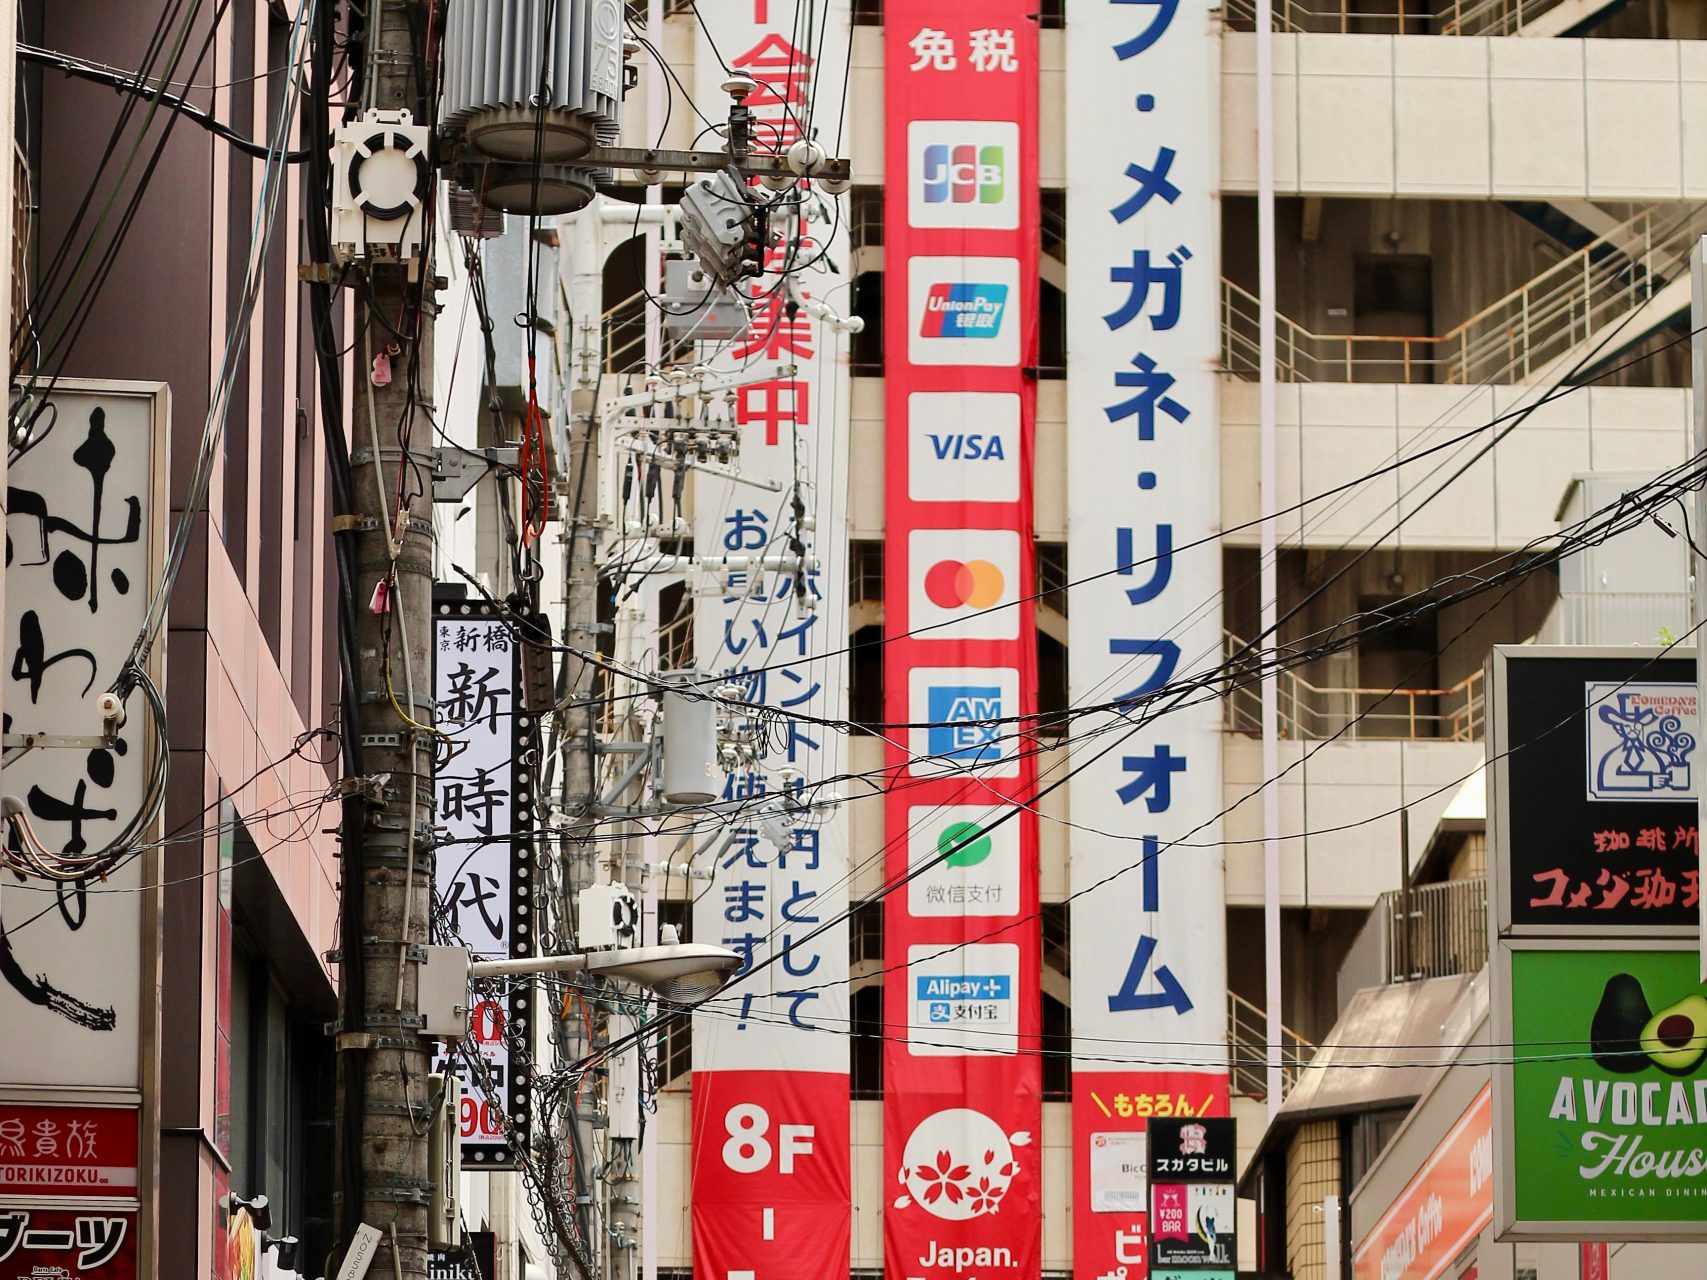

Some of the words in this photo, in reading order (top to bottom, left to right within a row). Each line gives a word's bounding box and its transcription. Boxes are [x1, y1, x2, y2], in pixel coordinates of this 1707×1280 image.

[908, 27, 1019, 73] 免税
[928, 296, 1003, 317] UnionPay
[925, 434, 1006, 461] VISA
[440, 625, 450, 652] 東京
[453, 625, 509, 653] 新橋
[1653, 705, 1698, 717] Coffee
[952, 726, 1001, 749] EX
[440, 661, 511, 941] 新時代
[926, 884, 1004, 905] 微信支付
[953, 1004, 999, 1021] 支付宝
[1113, 1093, 1196, 1119] もちろん
[722, 1102, 816, 1175] 8F
[1578, 1130, 1707, 1181] Hous
[1589, 1188, 1656, 1198] MEXICAN
[1161, 1220, 1182, 1233] BAR
[918, 1240, 1020, 1274] Japan.
